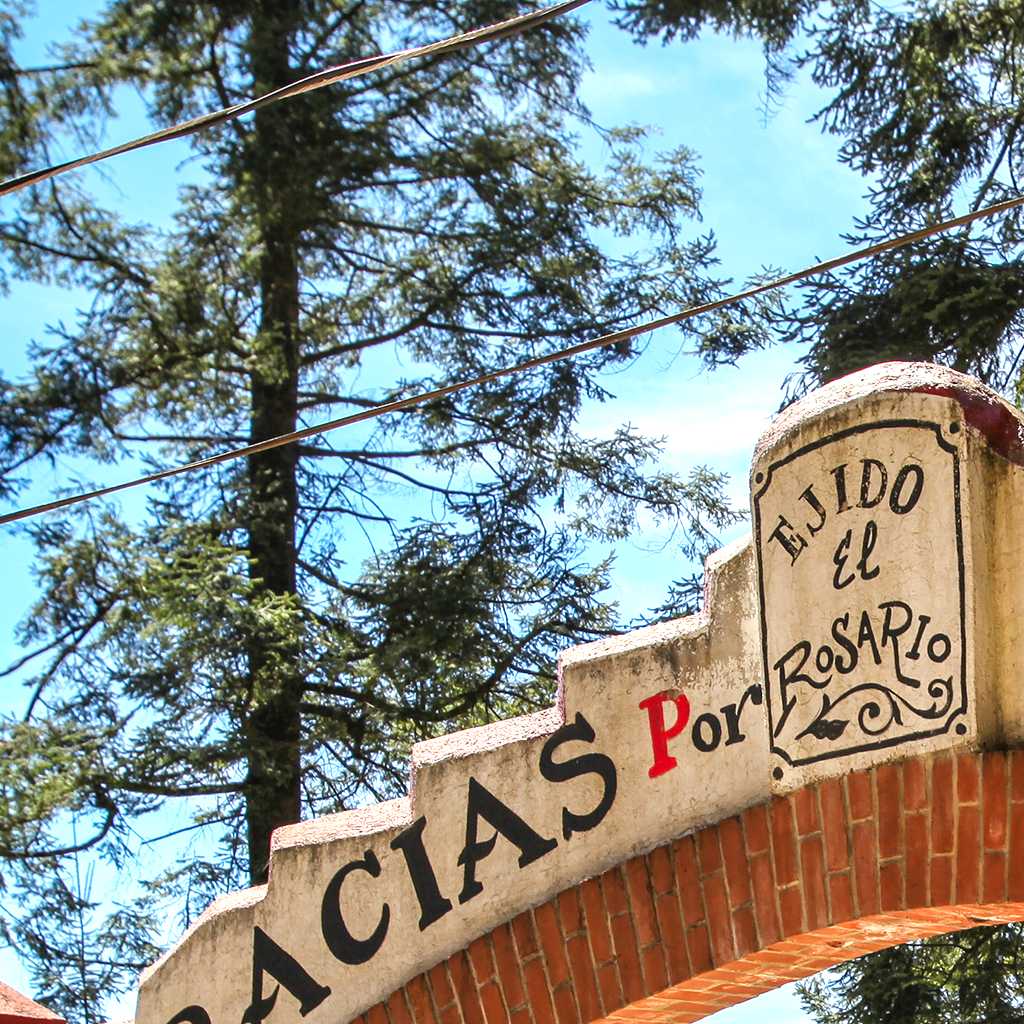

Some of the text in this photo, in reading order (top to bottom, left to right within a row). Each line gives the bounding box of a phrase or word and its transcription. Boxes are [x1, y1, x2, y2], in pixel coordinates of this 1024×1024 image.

[768, 457, 925, 567] EJIDO
[832, 519, 880, 590] El
[773, 600, 952, 738] ROSARIO
[639, 689, 764, 779] Por
